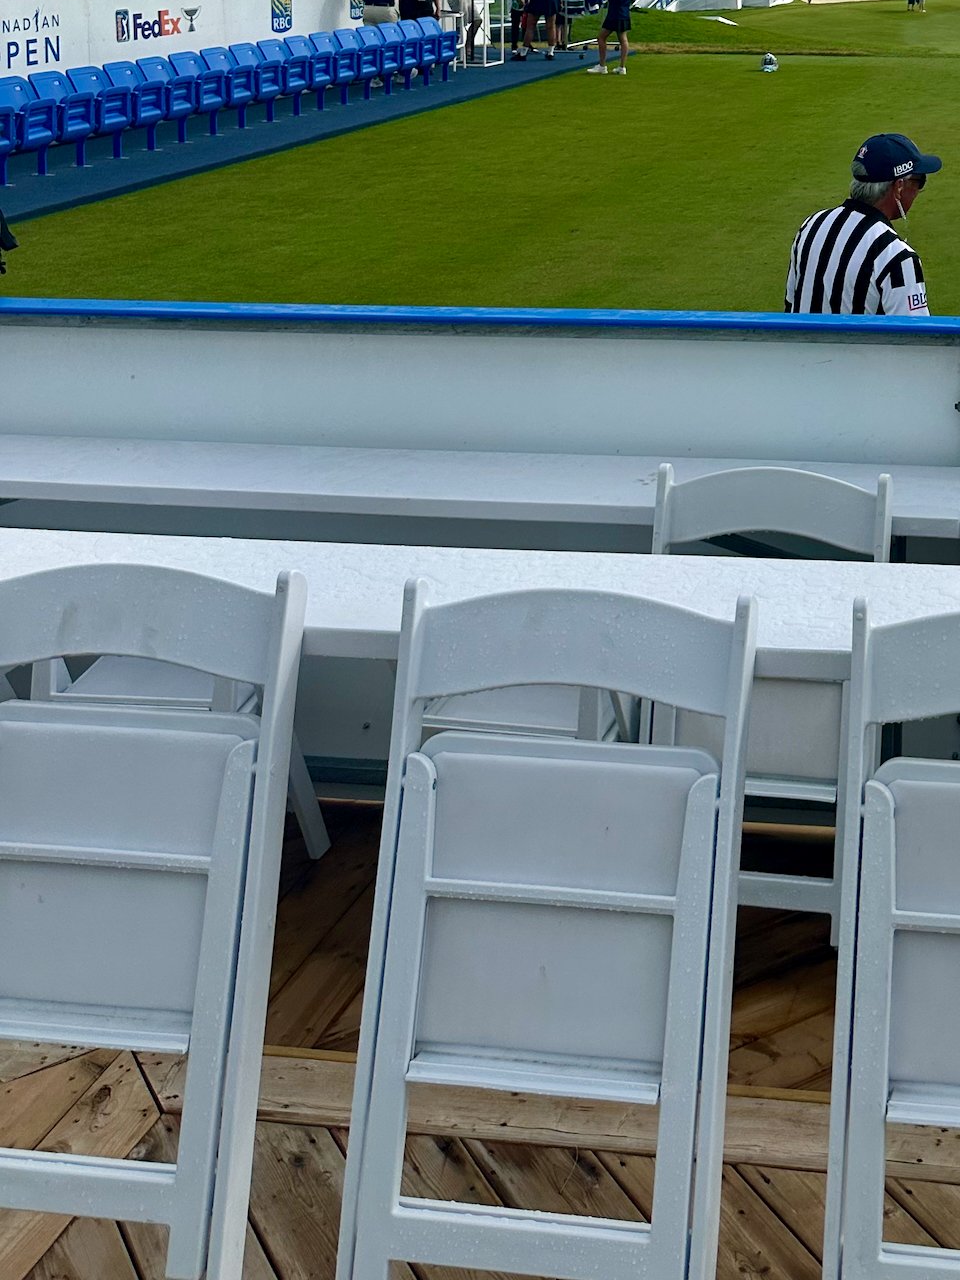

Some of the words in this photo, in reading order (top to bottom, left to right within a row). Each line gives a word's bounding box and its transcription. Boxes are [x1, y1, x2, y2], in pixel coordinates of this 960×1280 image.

[3, 9, 60, 33] NADIAN
[133, 10, 181, 40] FedEx
[273, 17, 291, 30] RBC
[7, 35, 60, 69] PEN
[896, 160, 913, 175] BDO
